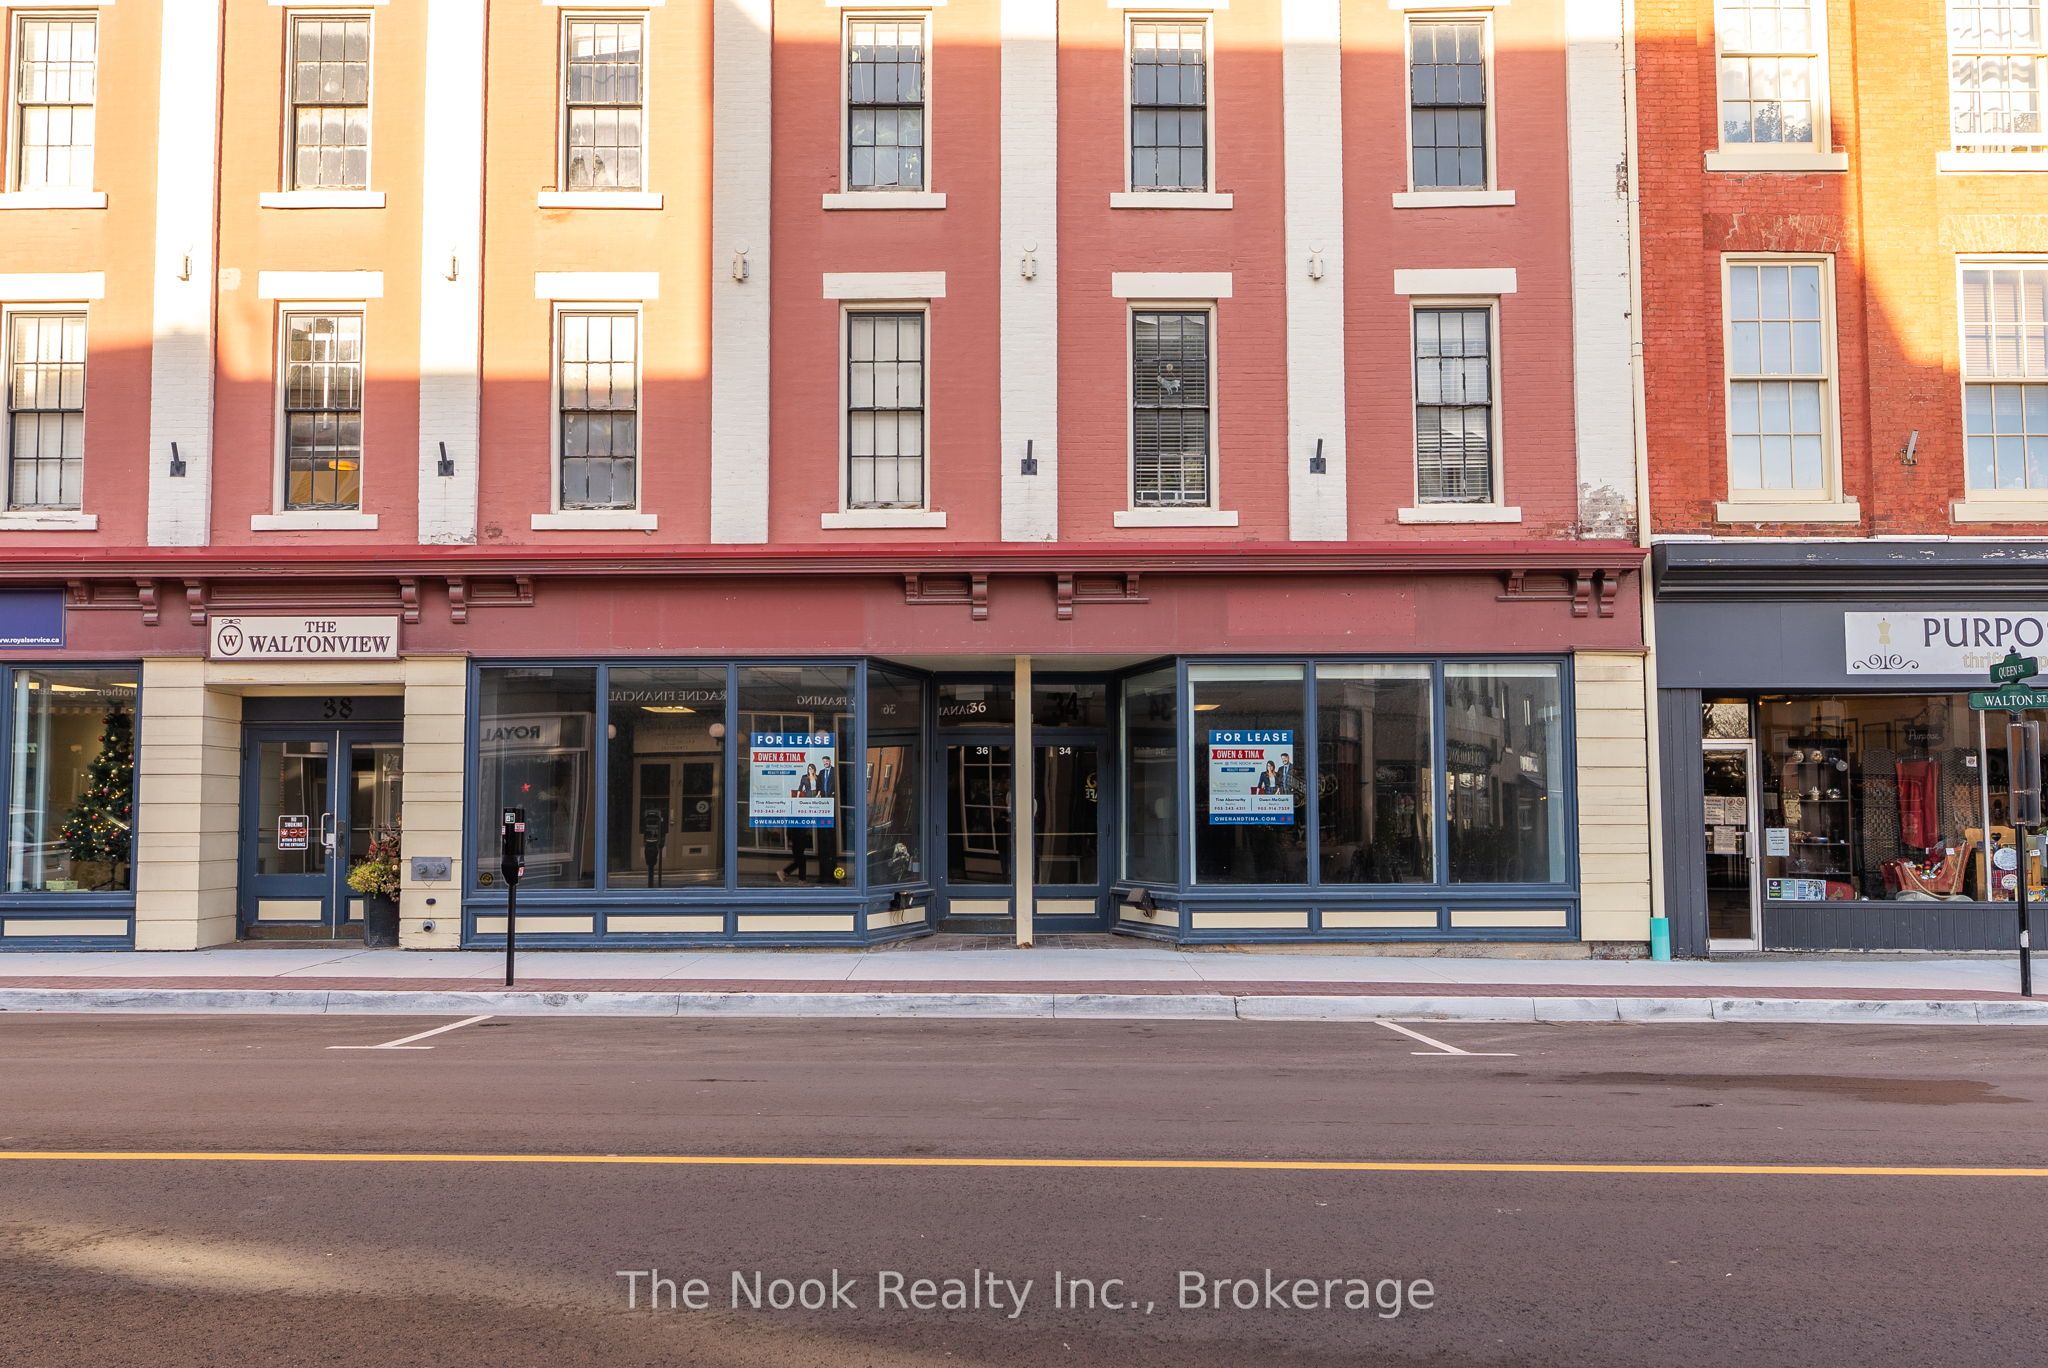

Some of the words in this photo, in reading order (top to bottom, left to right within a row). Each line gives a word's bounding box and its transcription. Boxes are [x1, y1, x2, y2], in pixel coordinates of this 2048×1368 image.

[304, 622, 336, 632] THE
[1924, 618, 2048, 647] PURPO
[222, 635, 238, 648] W
[248, 636, 391, 652] WALTONVIEW
[1998, 666, 2017, 680] QUEEN
[1051, 692, 1078, 720] 34
[1984, 696, 2032, 706] WALTON
[324, 698, 352, 719] 38
[970, 702, 986, 713] 36
[757, 736, 782, 744] FOR
[789, 736, 830, 744] LEASE
[1216, 733, 1240, 742] FOR
[1248, 733, 1287, 742] LEASE
[976, 747, 988, 755] 36
[1059, 747, 1071, 755] 34
[1216, 750, 1236, 758] OWEN
[1245, 750, 1259, 758] TINA
[757, 753, 777, 761] OWEN
[779, 753, 784, 761] &
[786, 753, 801, 761] TINA
